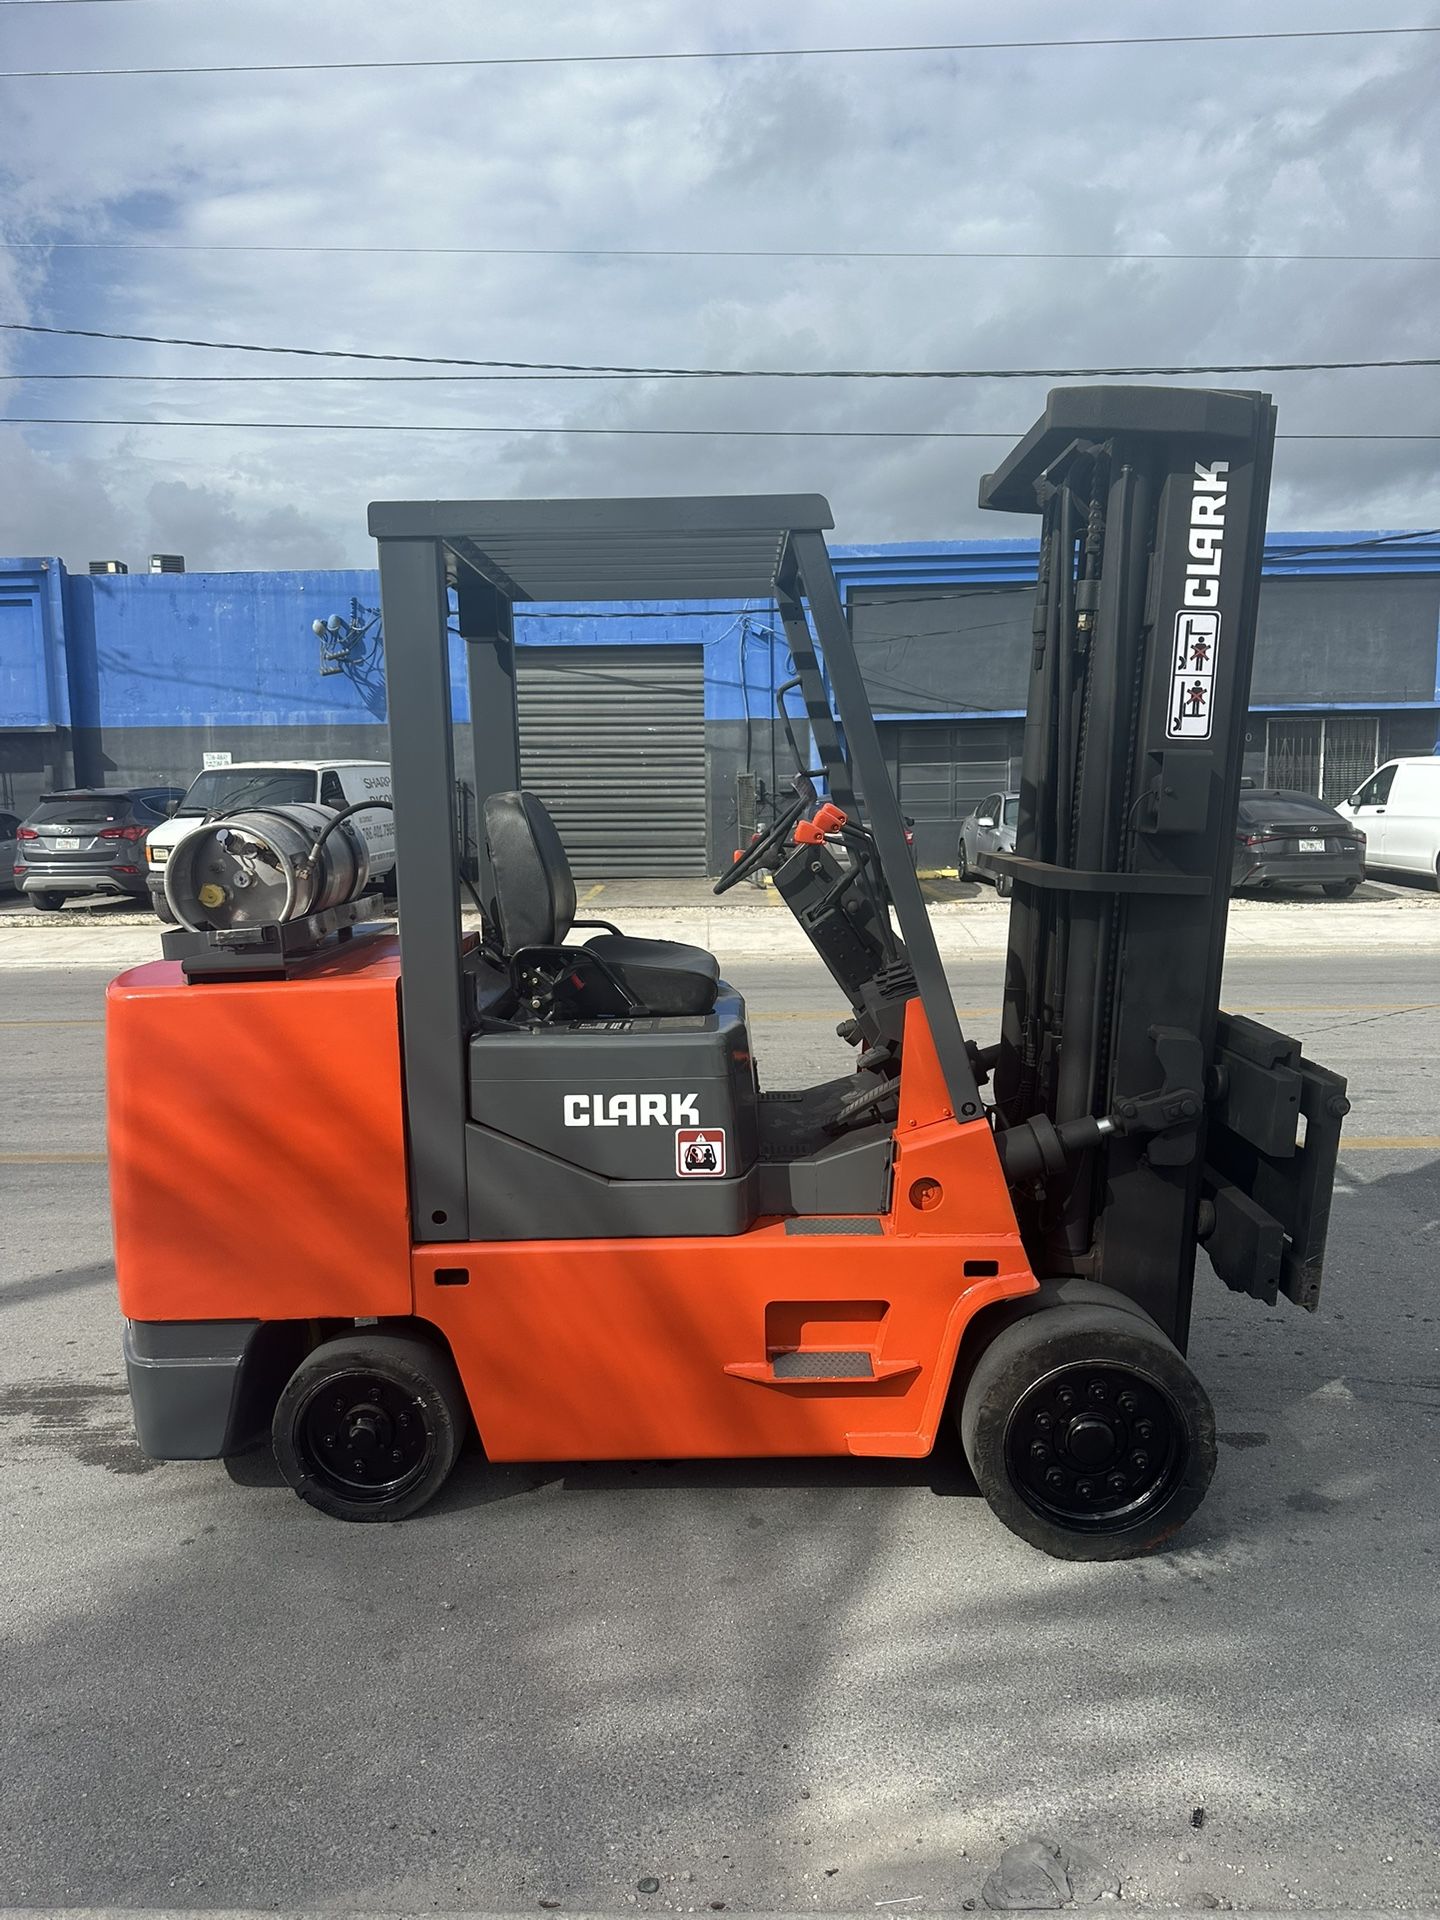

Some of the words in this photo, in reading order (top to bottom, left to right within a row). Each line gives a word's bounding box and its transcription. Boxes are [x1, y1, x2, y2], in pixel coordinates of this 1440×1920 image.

[1183, 461, 1229, 607] CLARK
[363, 776, 391, 789] SHARP
[563, 1093, 700, 1127] CLARK
